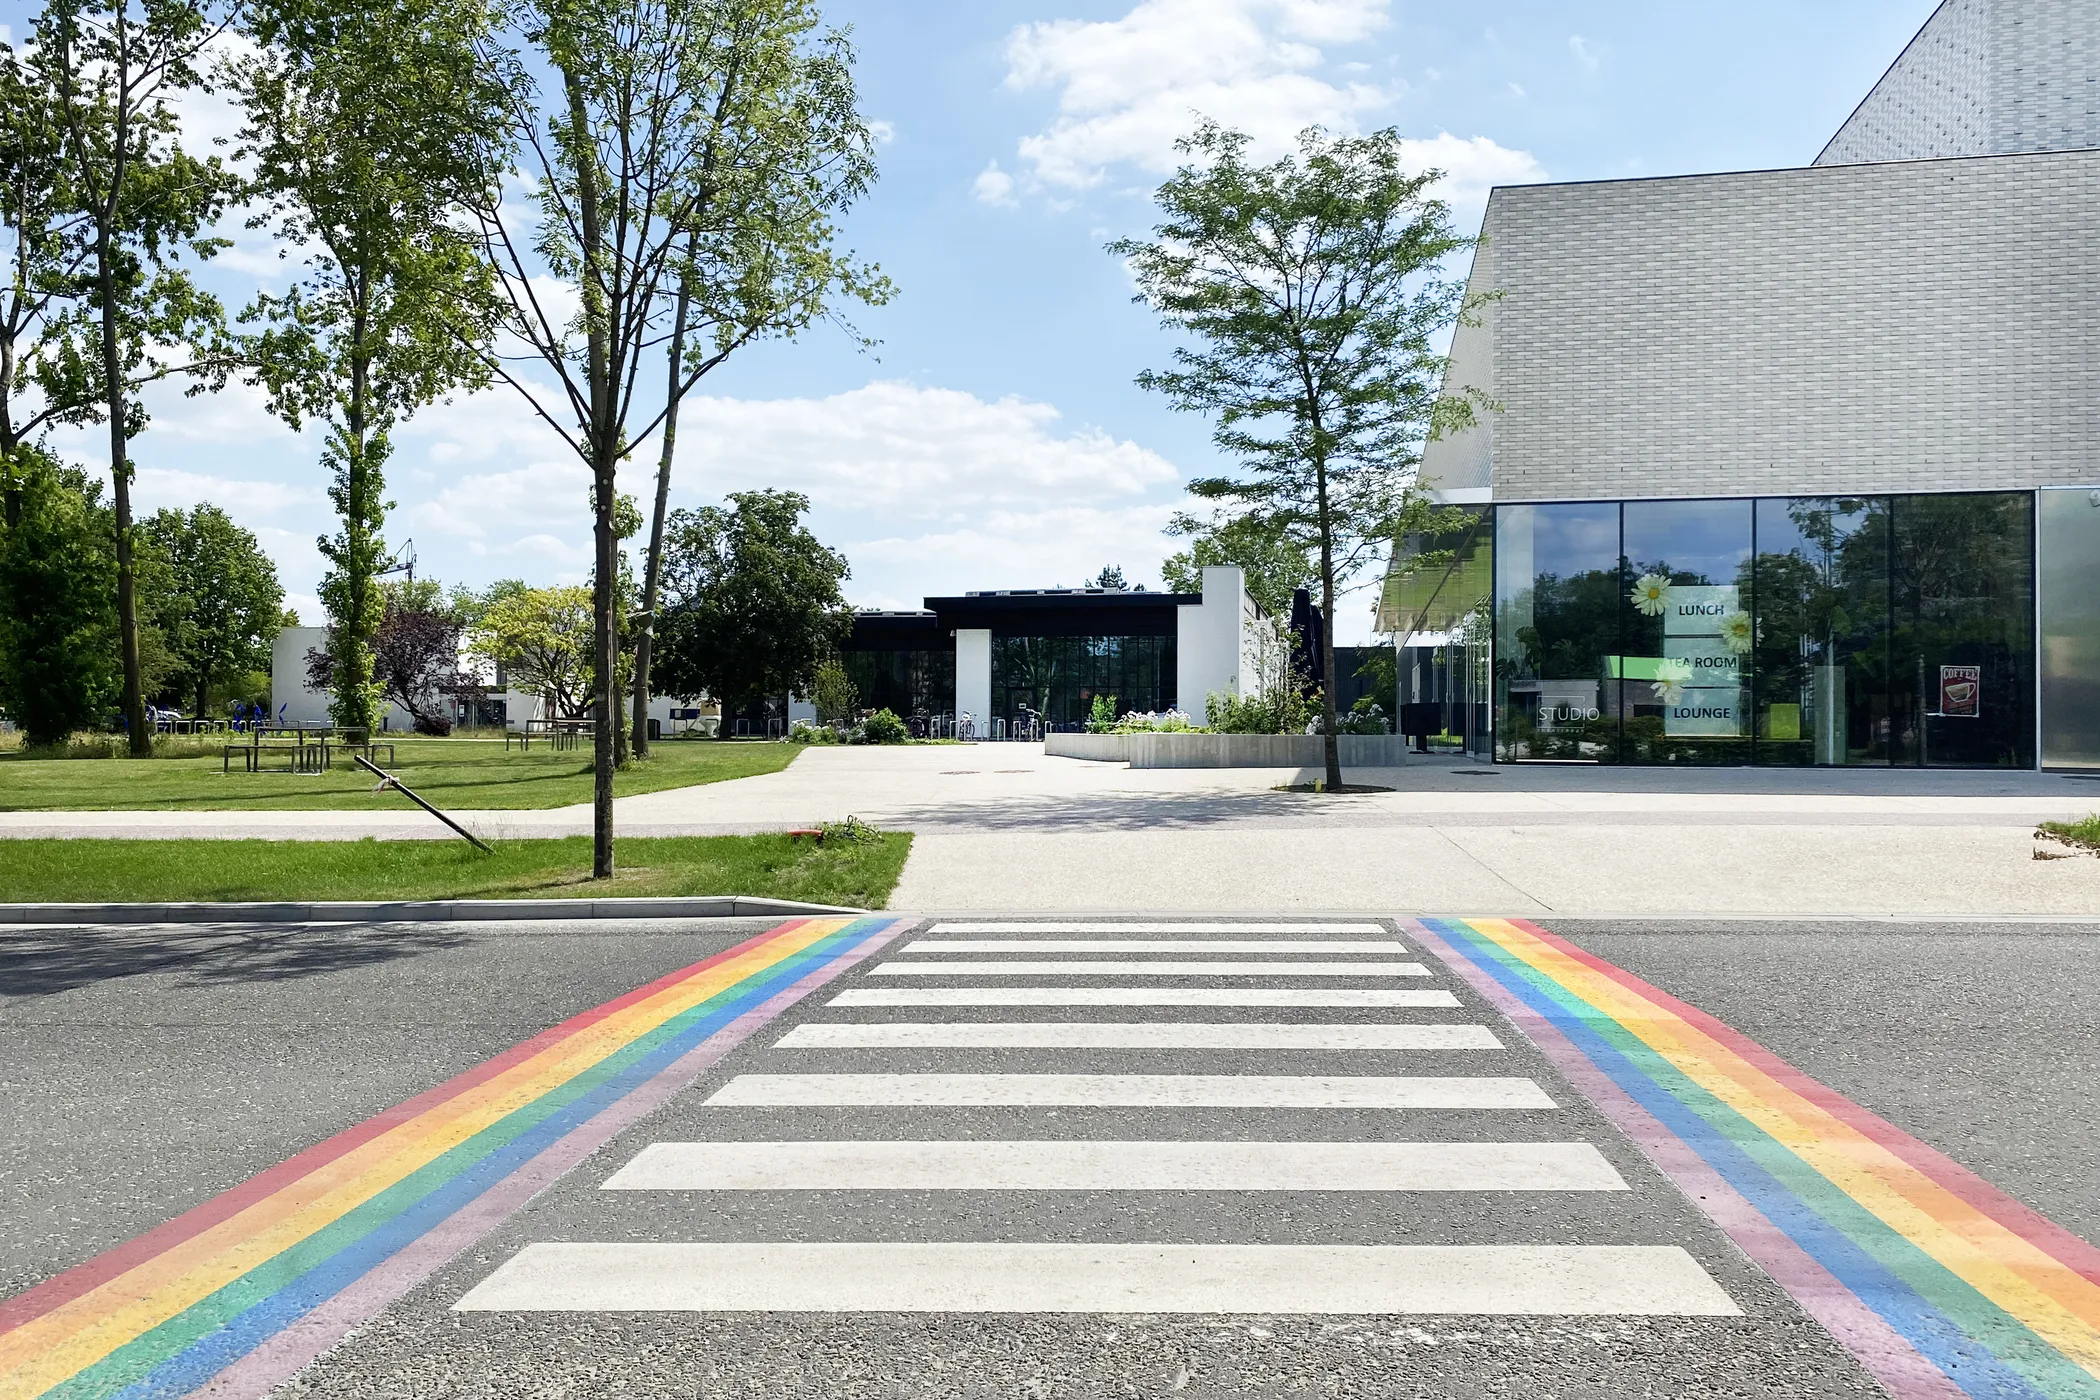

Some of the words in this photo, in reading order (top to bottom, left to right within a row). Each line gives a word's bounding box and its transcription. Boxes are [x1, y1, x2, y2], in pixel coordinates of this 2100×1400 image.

[1679, 605, 1724, 616] LUNCH
[1667, 657, 1691, 668] TEA
[1695, 657, 1737, 668] ROOM
[1943, 668, 1977, 680] COFFEE
[1538, 707, 1600, 721] STUDIO
[1674, 708, 1731, 719] LOUNGE
